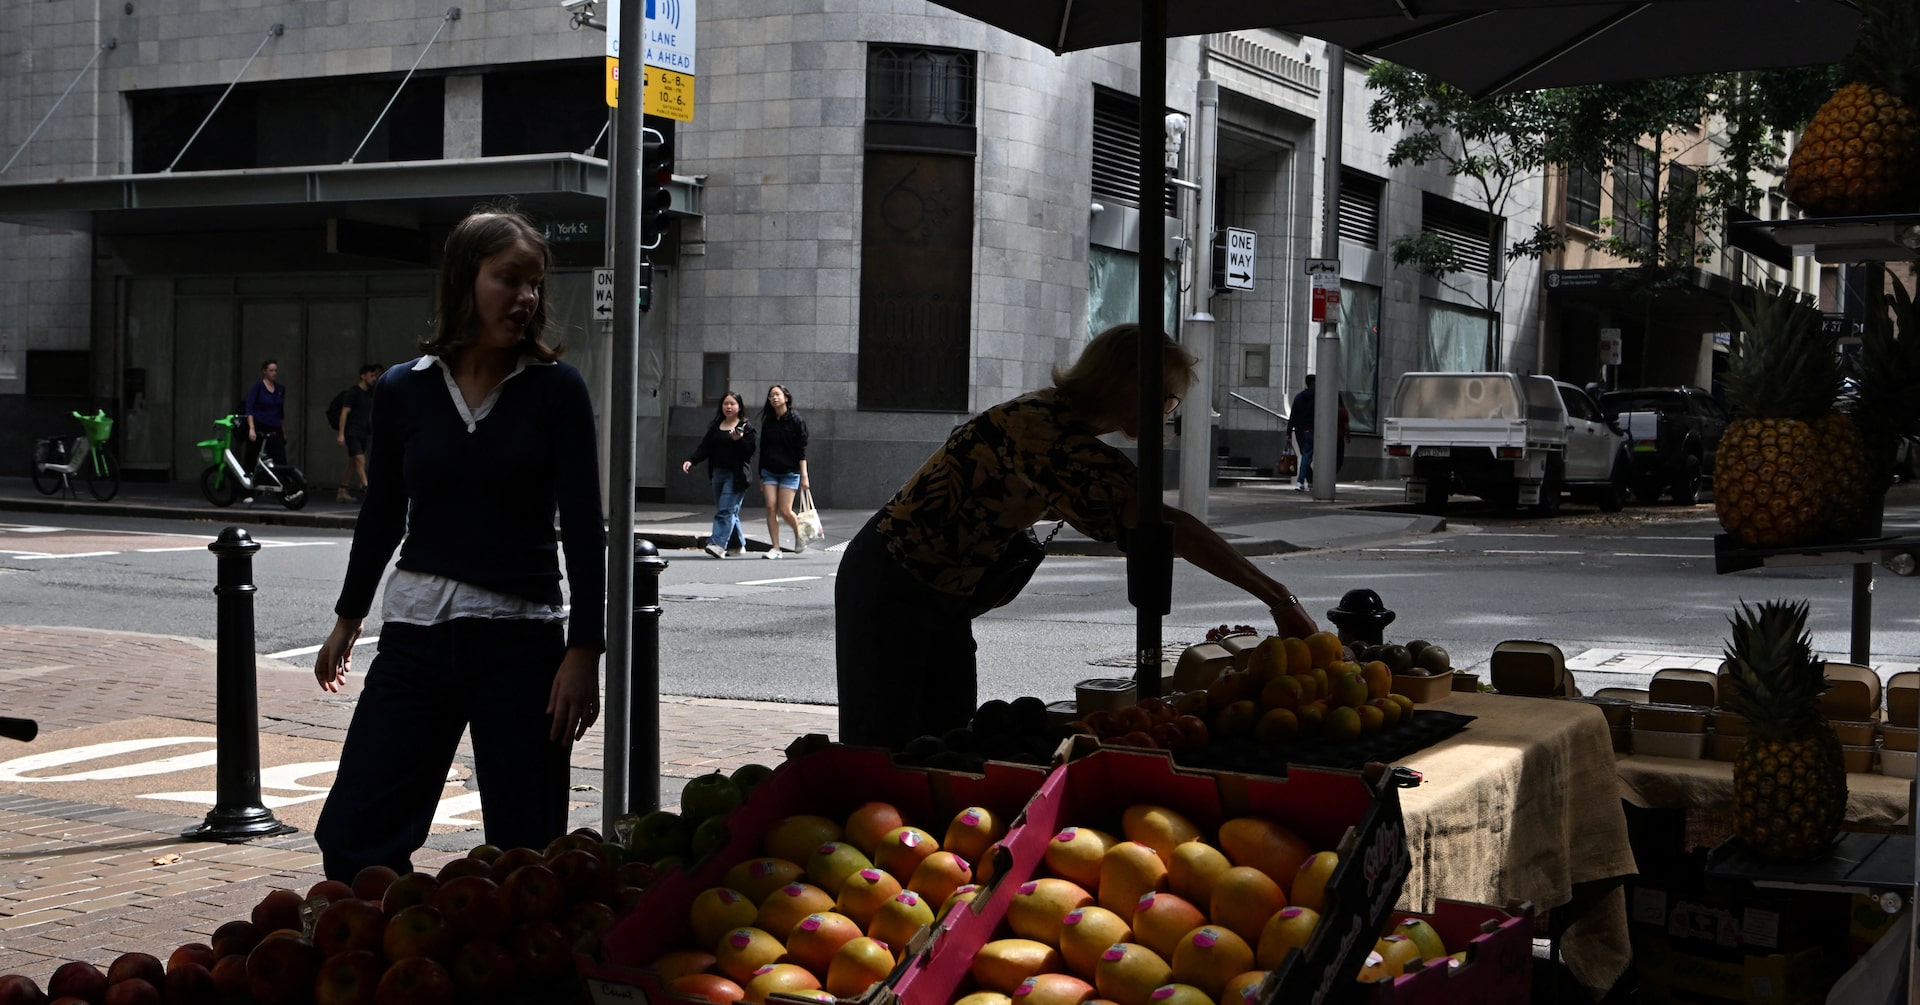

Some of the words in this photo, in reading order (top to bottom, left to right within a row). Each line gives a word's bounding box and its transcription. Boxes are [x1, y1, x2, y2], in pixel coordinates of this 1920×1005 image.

[652, 30, 677, 47] LANE
[658, 51, 690, 69] AHEAD
[557, 223, 577, 234] York
[579, 222, 588, 234] St
[1231, 234, 1252, 250] ONE
[1230, 252, 1252, 268] WAY
[597, 273, 613, 286] ON
[596, 290, 613, 301] WA
